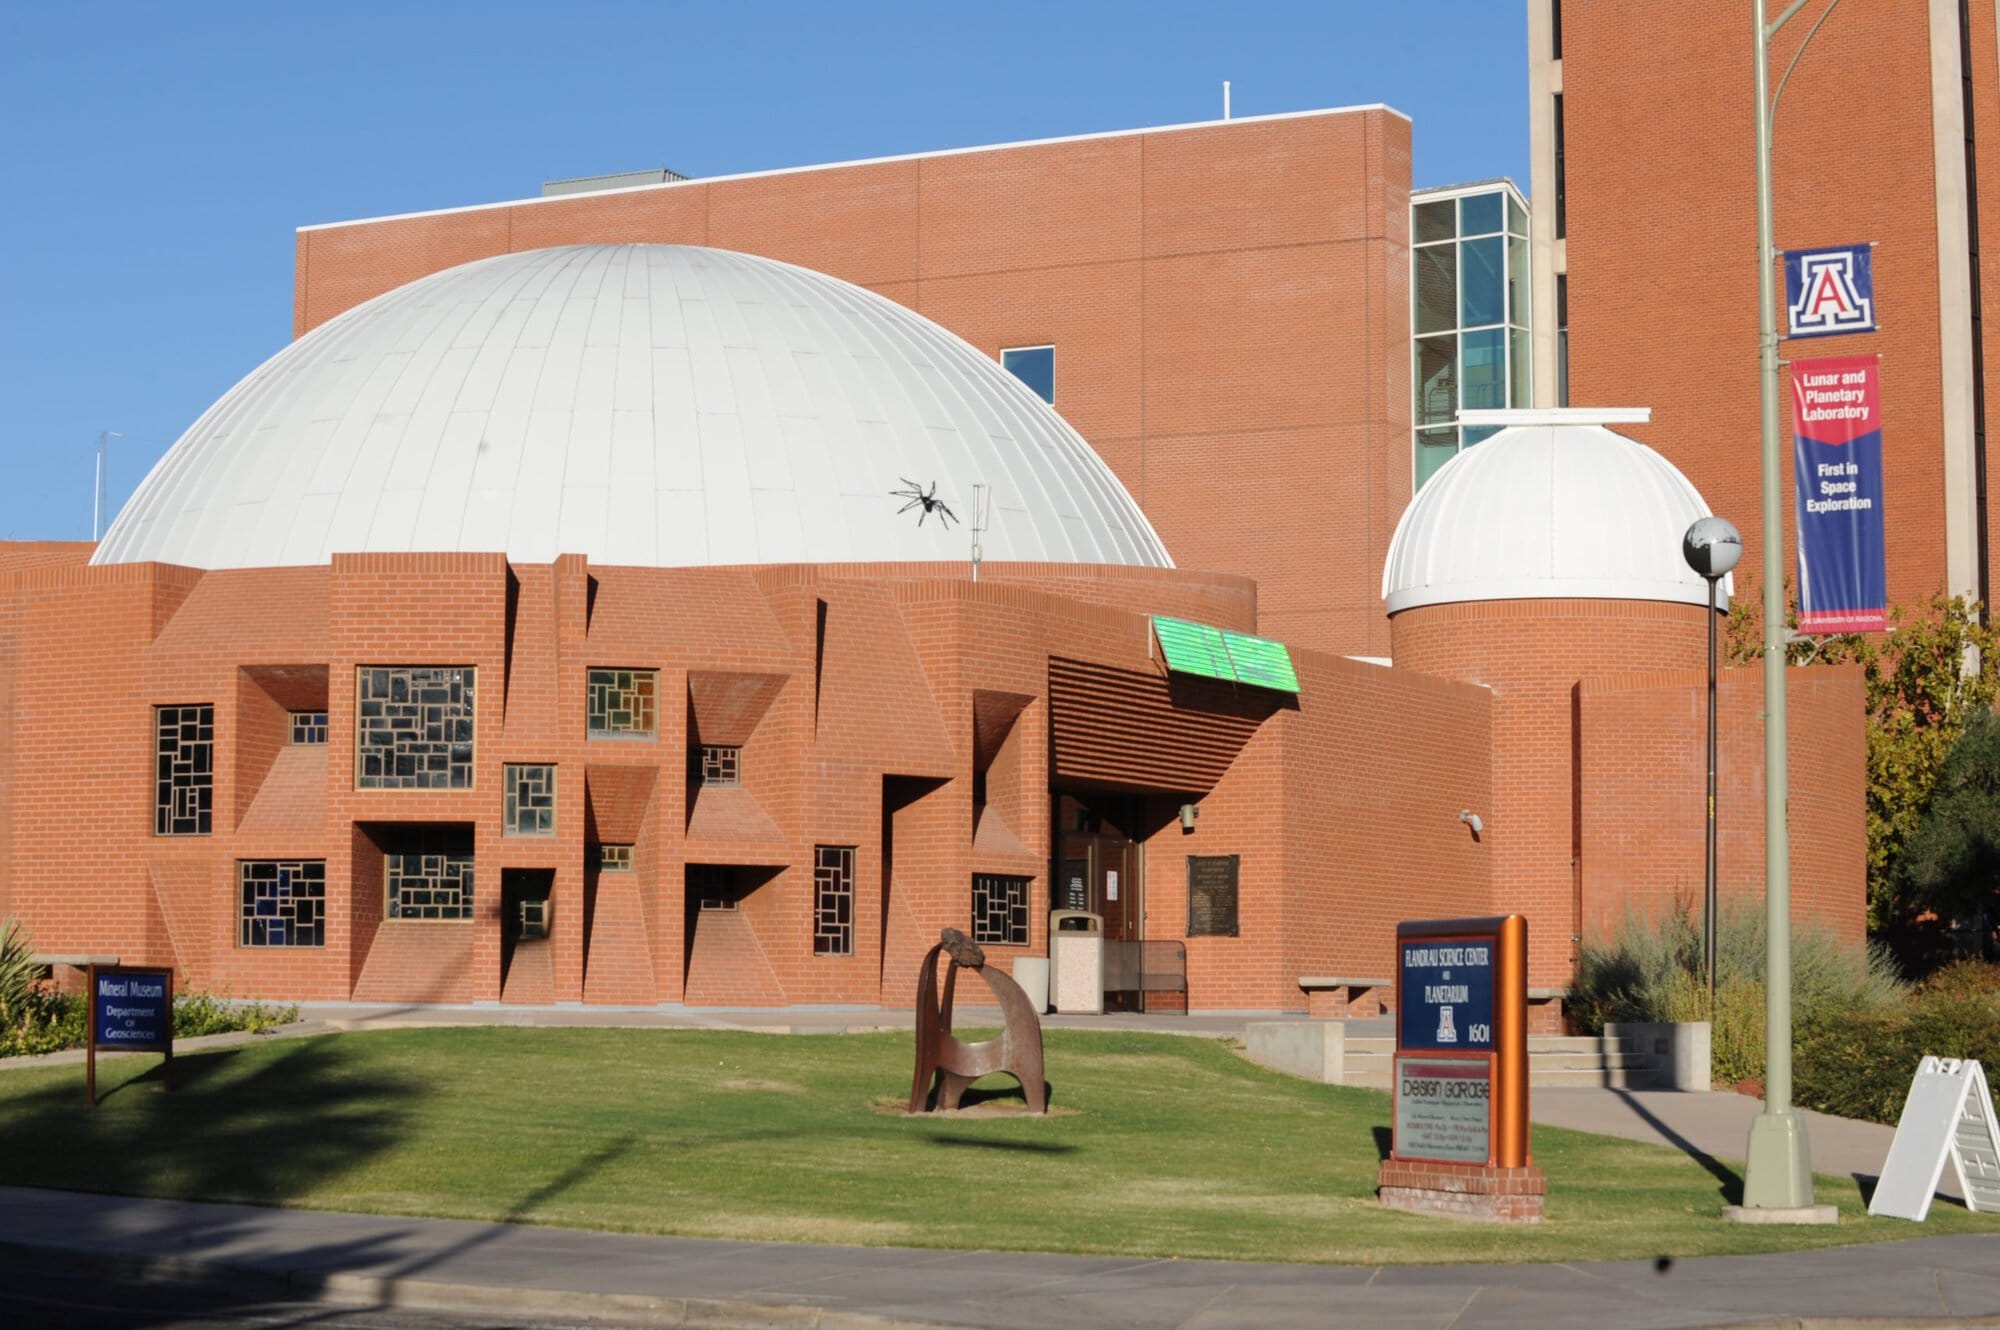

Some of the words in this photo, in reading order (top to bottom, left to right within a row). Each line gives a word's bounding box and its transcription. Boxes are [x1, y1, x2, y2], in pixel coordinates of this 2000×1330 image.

[1789, 251, 1872, 334] A
[1803, 373, 1839, 387] Lunar
[1842, 370, 1866, 384] and
[1806, 389, 1865, 404] Planetary
[1802, 406, 1869, 421] Laboratory
[1818, 463, 1845, 477] First
[1846, 462, 1858, 475] in
[1820, 481, 1857, 496] Space
[1806, 497, 1872, 514] Exploration
[1439, 948, 1464, 966] SCIENCE
[1465, 947, 1489, 966] CENTER
[99, 980, 128, 997] Mineral
[130, 981, 162, 997] Museum
[106, 1005, 155, 1020] Department
[1436, 1005, 1458, 1042] A
[105, 1027, 155, 1039] Geosciences
[1469, 1024, 1490, 1042] 1601
